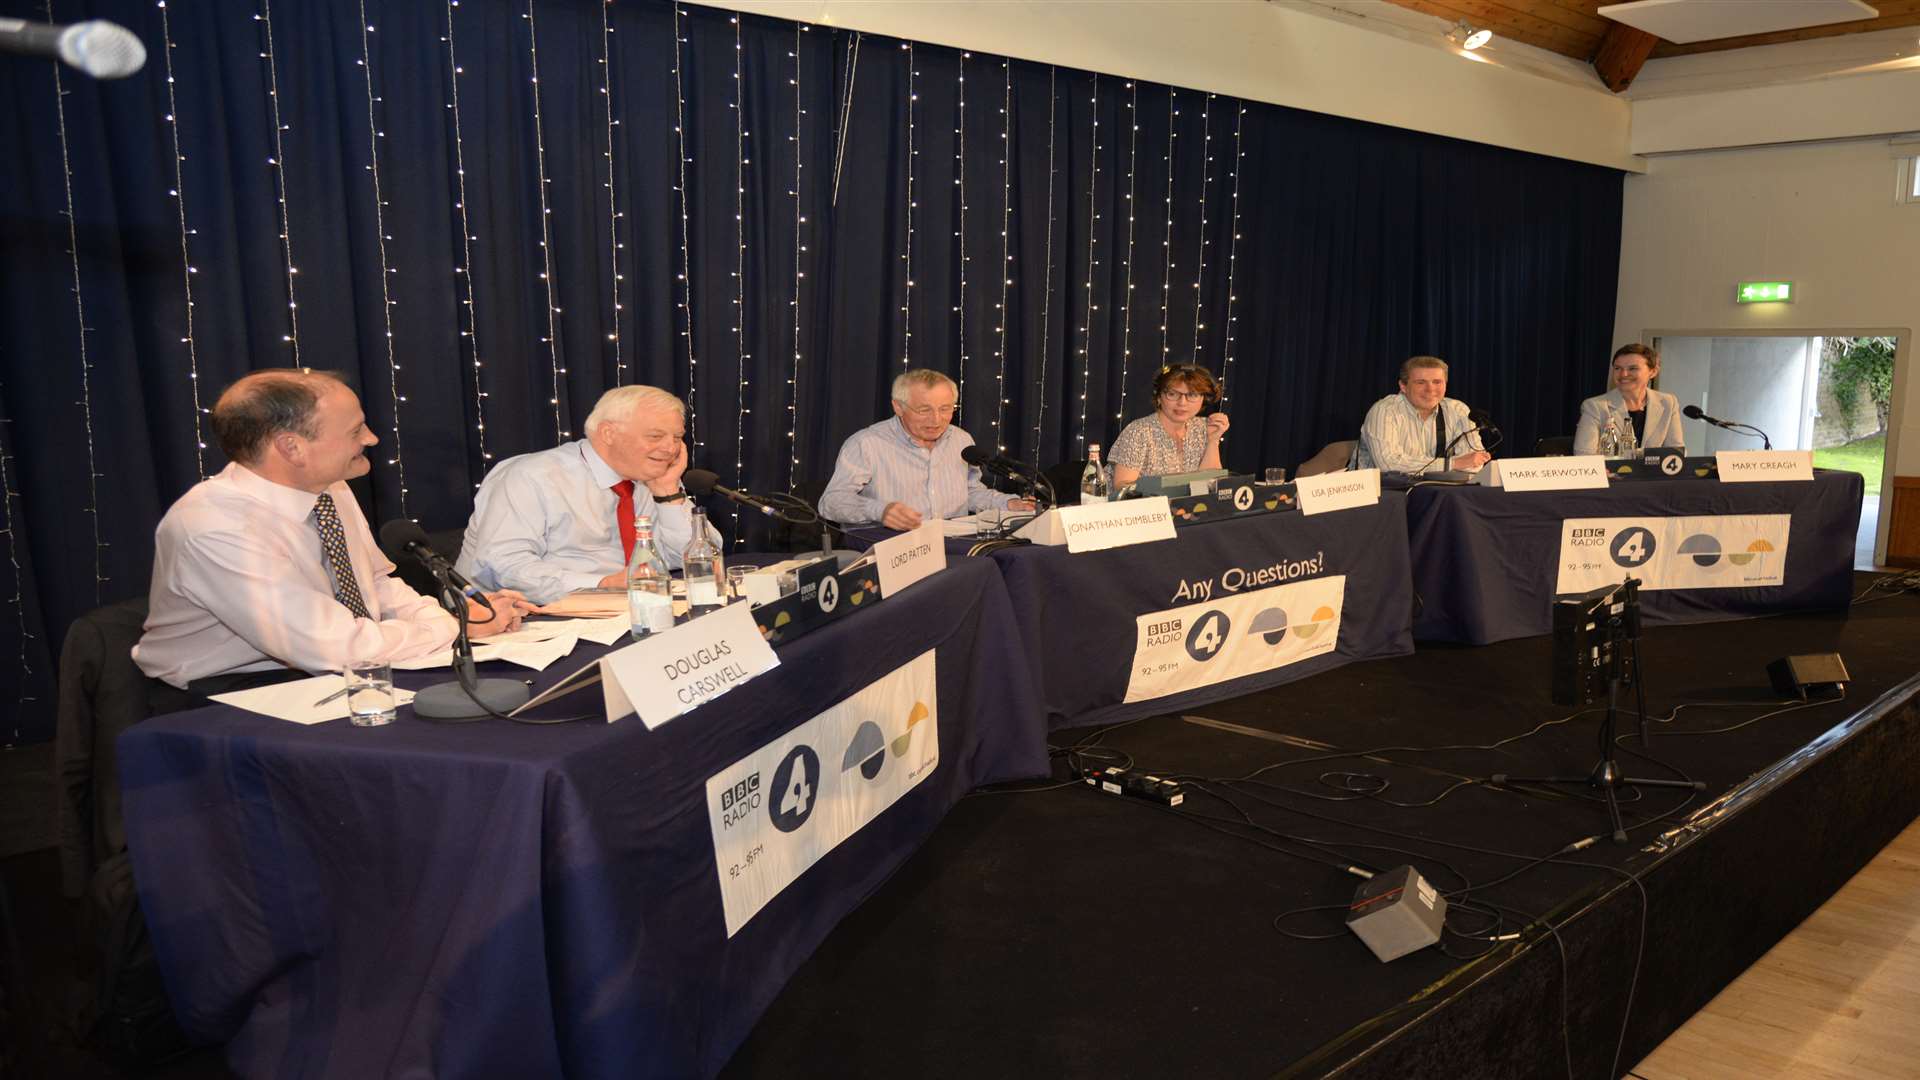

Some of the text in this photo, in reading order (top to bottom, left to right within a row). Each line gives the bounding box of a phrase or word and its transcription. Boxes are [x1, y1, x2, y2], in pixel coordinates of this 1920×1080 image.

[1665, 458, 1678, 471] 4
[1732, 462, 1797, 470] MARY CREAGH
[1509, 468, 1598, 479] MARK SERWOTKA
[1238, 489, 1249, 506] 4
[1311, 483, 1365, 498] LISA JENKINSON
[1069, 512, 1167, 536] JONATHAN DIMBLEBY
[1572, 528, 1606, 538] BBC
[1570, 538, 1605, 546] RADIO
[891, 543, 931, 569] LORD PATTEN
[1171, 551, 1324, 603] Any Questions?
[823, 581, 835, 605] 4
[1148, 619, 1182, 636] BBC
[1147, 632, 1182, 647] RADIO
[663, 639, 732, 681] DOUGLAS
[677, 662, 748, 704] CARSWELL
[721, 772, 760, 812] BBC
[722, 793, 761, 831] RADIO
